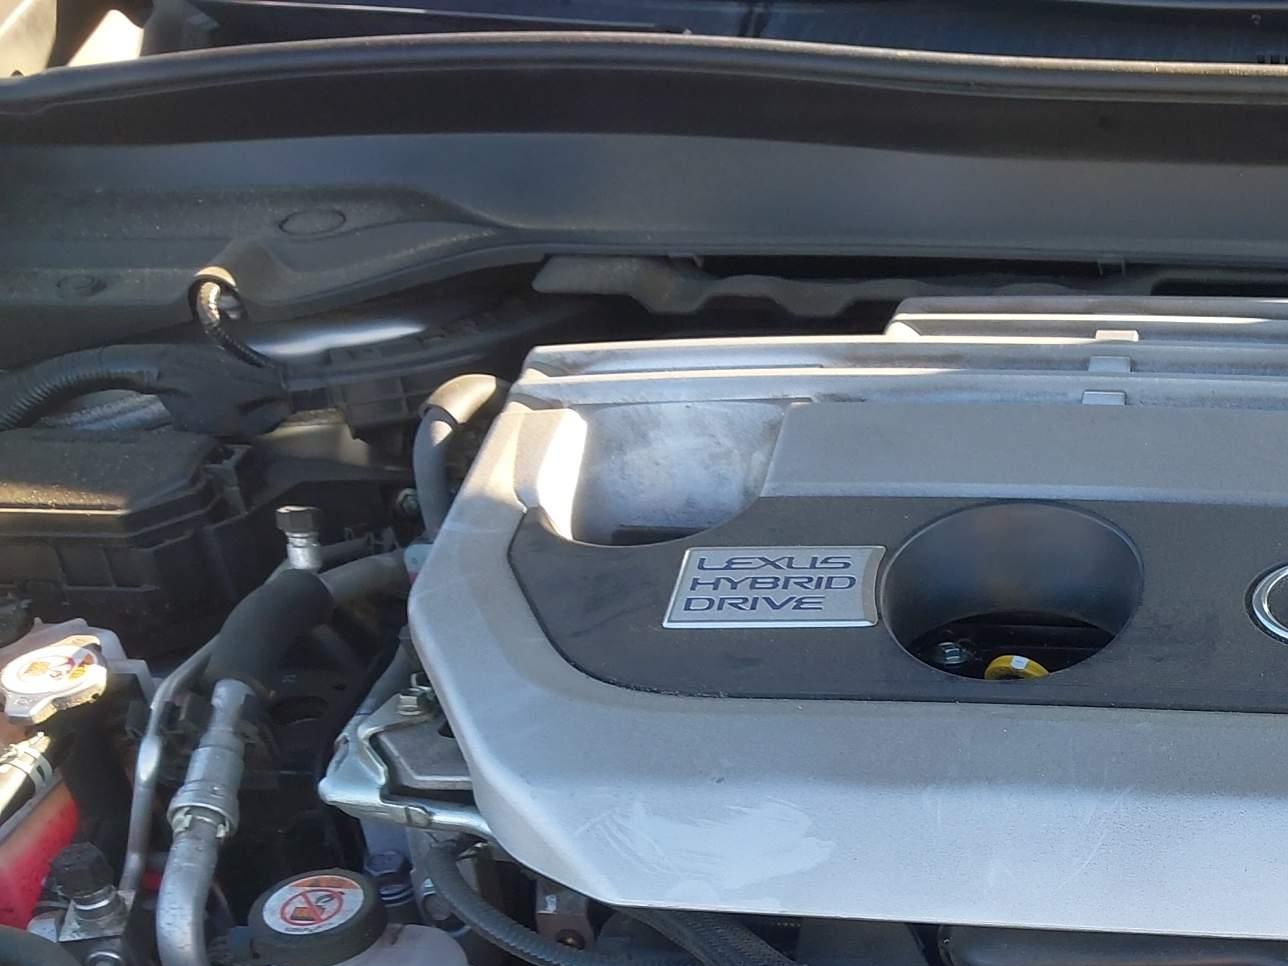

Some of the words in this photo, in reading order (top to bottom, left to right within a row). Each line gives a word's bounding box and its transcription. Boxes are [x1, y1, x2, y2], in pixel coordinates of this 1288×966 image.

[697, 556, 852, 571] LEXUS
[690, 575, 857, 591] HYBRID
[683, 596, 826, 612] DRIVE
